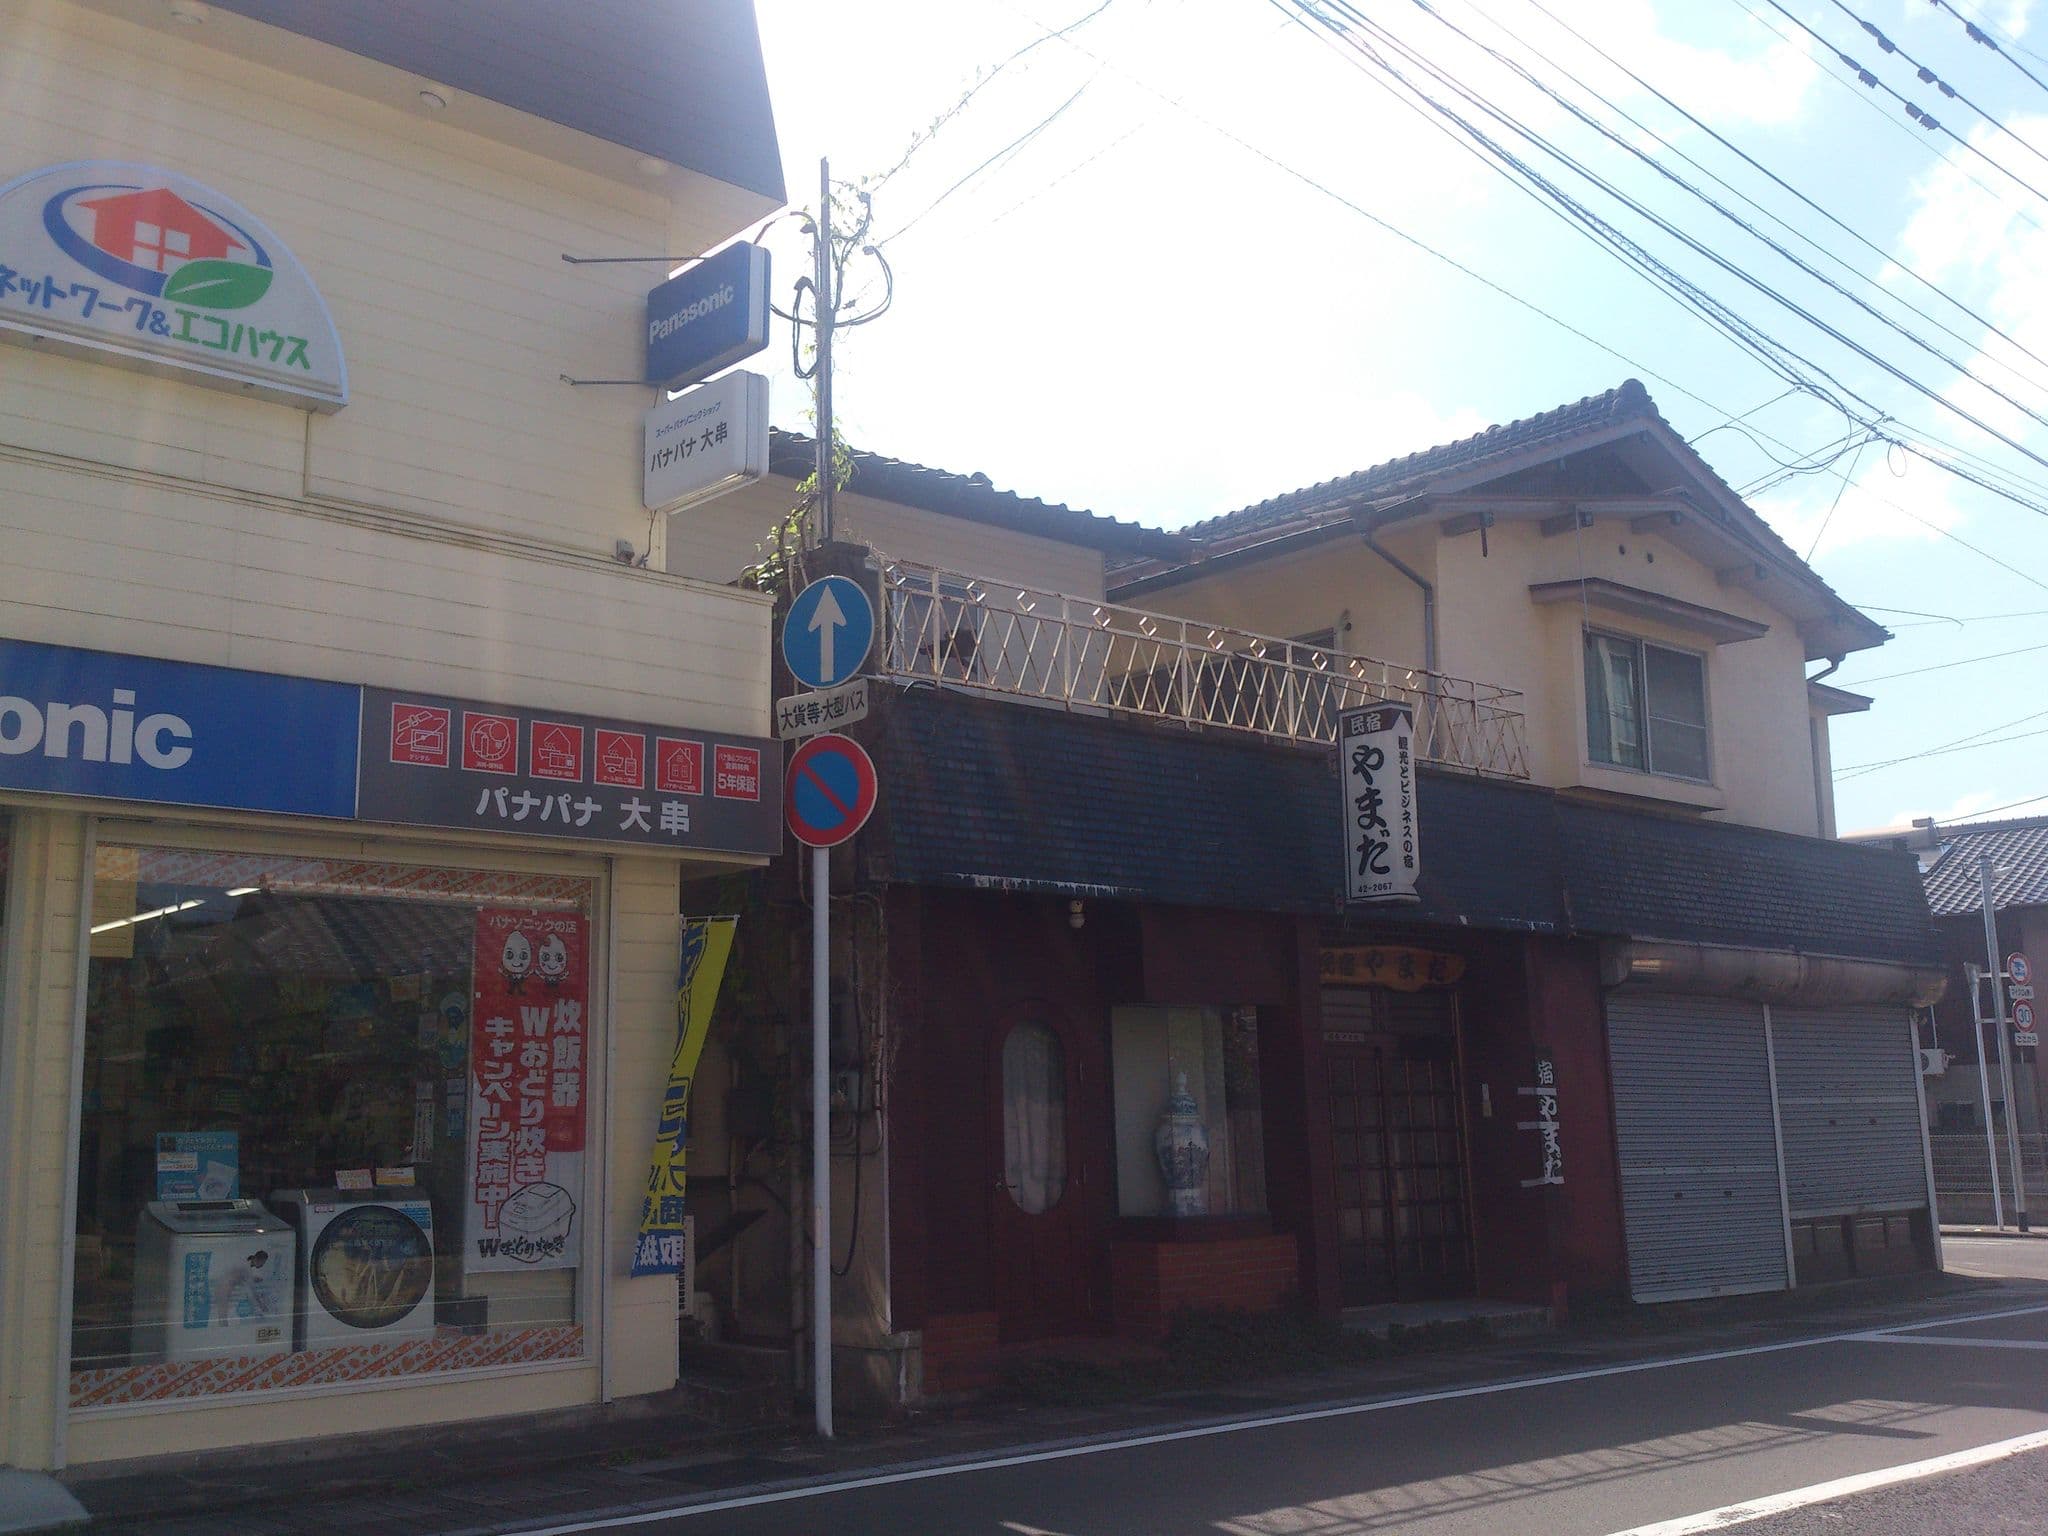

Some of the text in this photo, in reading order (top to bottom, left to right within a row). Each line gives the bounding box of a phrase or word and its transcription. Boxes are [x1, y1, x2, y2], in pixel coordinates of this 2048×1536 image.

[650, 282, 734, 344] Panasonic
[701, 421, 728, 451] 大串
[0, 688, 193, 770] onic
[1349, 712, 1382, 734] 民宿
[717, 773, 756, 793] 5年保証
[1352, 744, 1391, 876] やまだ
[1398, 736, 1414, 869] 観光とビジネスの宿
[475, 787, 690, 836] パナパナ 大串
[489, 915, 577, 934] パナソニックの店
[2018, 1009, 2031, 1023] 30
[552, 998, 581, 1107] 炊飯器
[514, 1005, 551, 1185] Wおどり炊き
